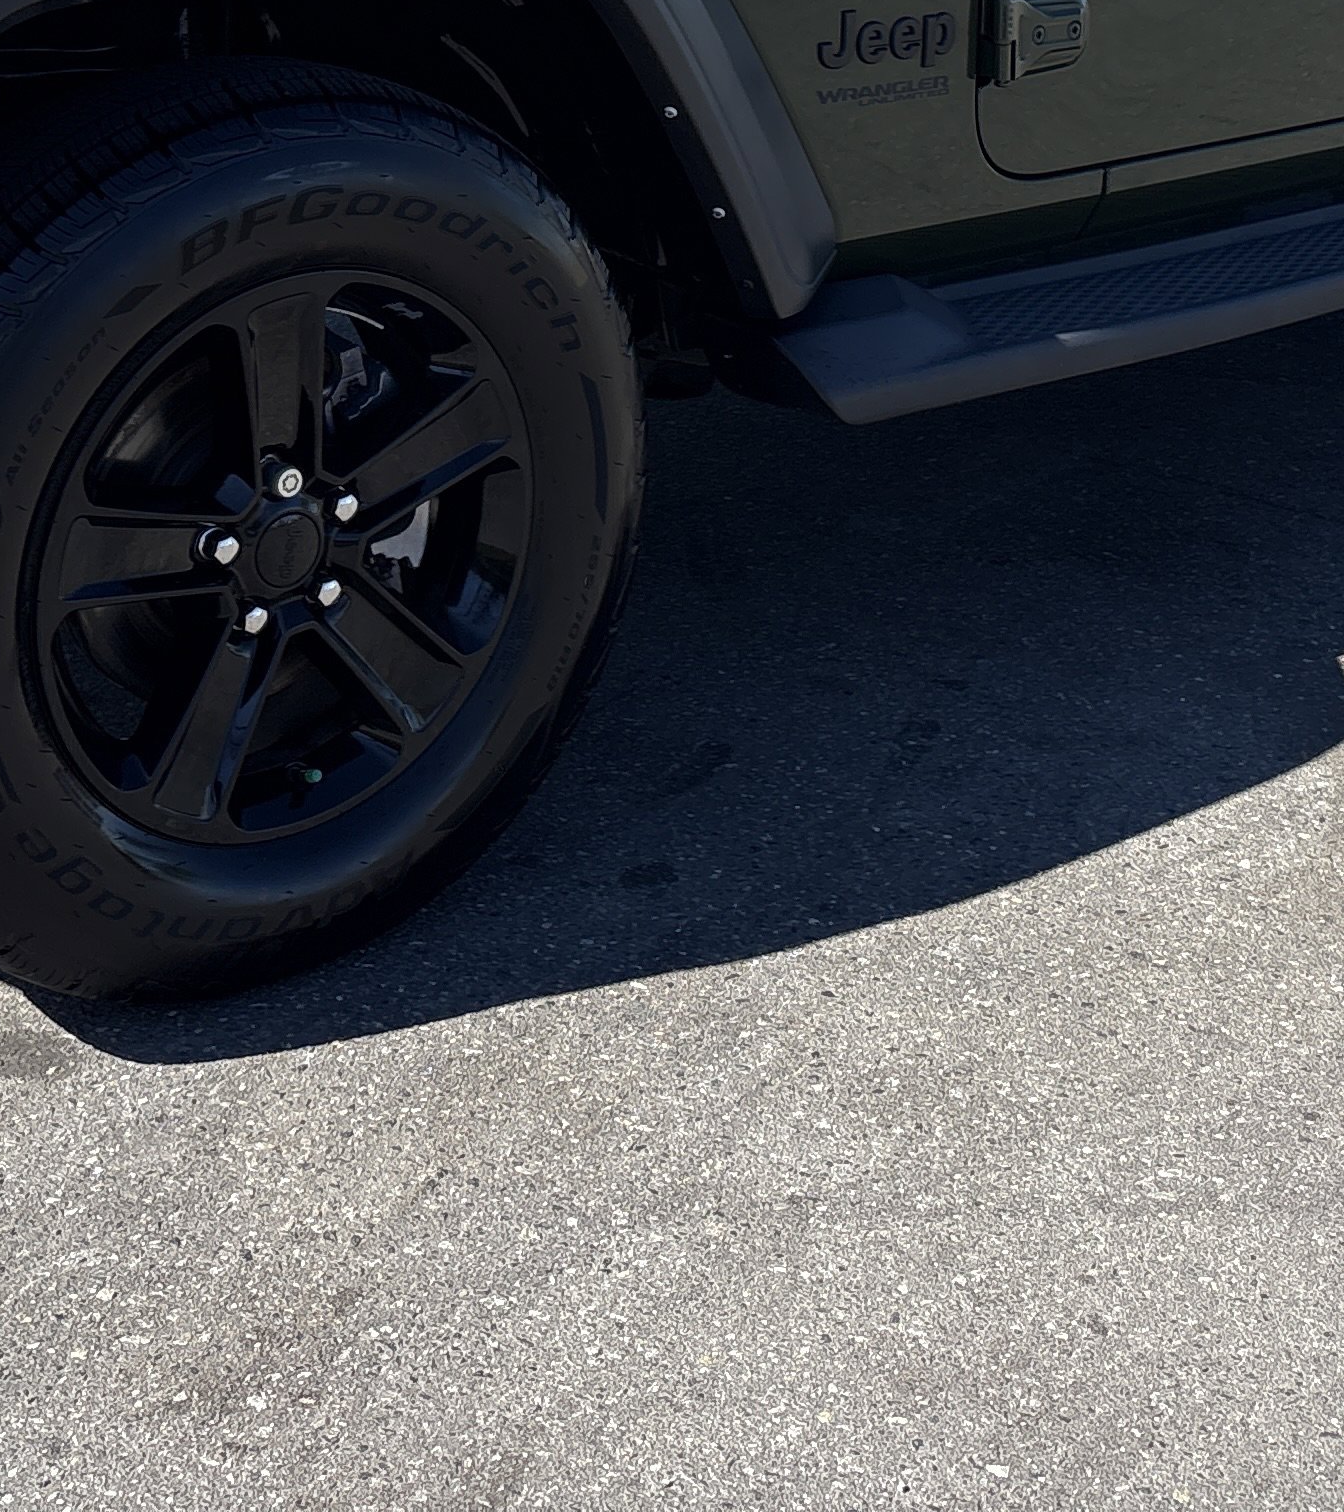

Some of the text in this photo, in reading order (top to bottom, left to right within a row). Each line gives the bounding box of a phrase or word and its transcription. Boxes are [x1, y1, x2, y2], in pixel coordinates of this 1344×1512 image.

[817, 9, 956, 69] Jeep
[816, 75, 949, 104] WRANGLER
[858, 88, 949, 106] UNLIMITED
[180, 184, 583, 354] BFGoodrich
